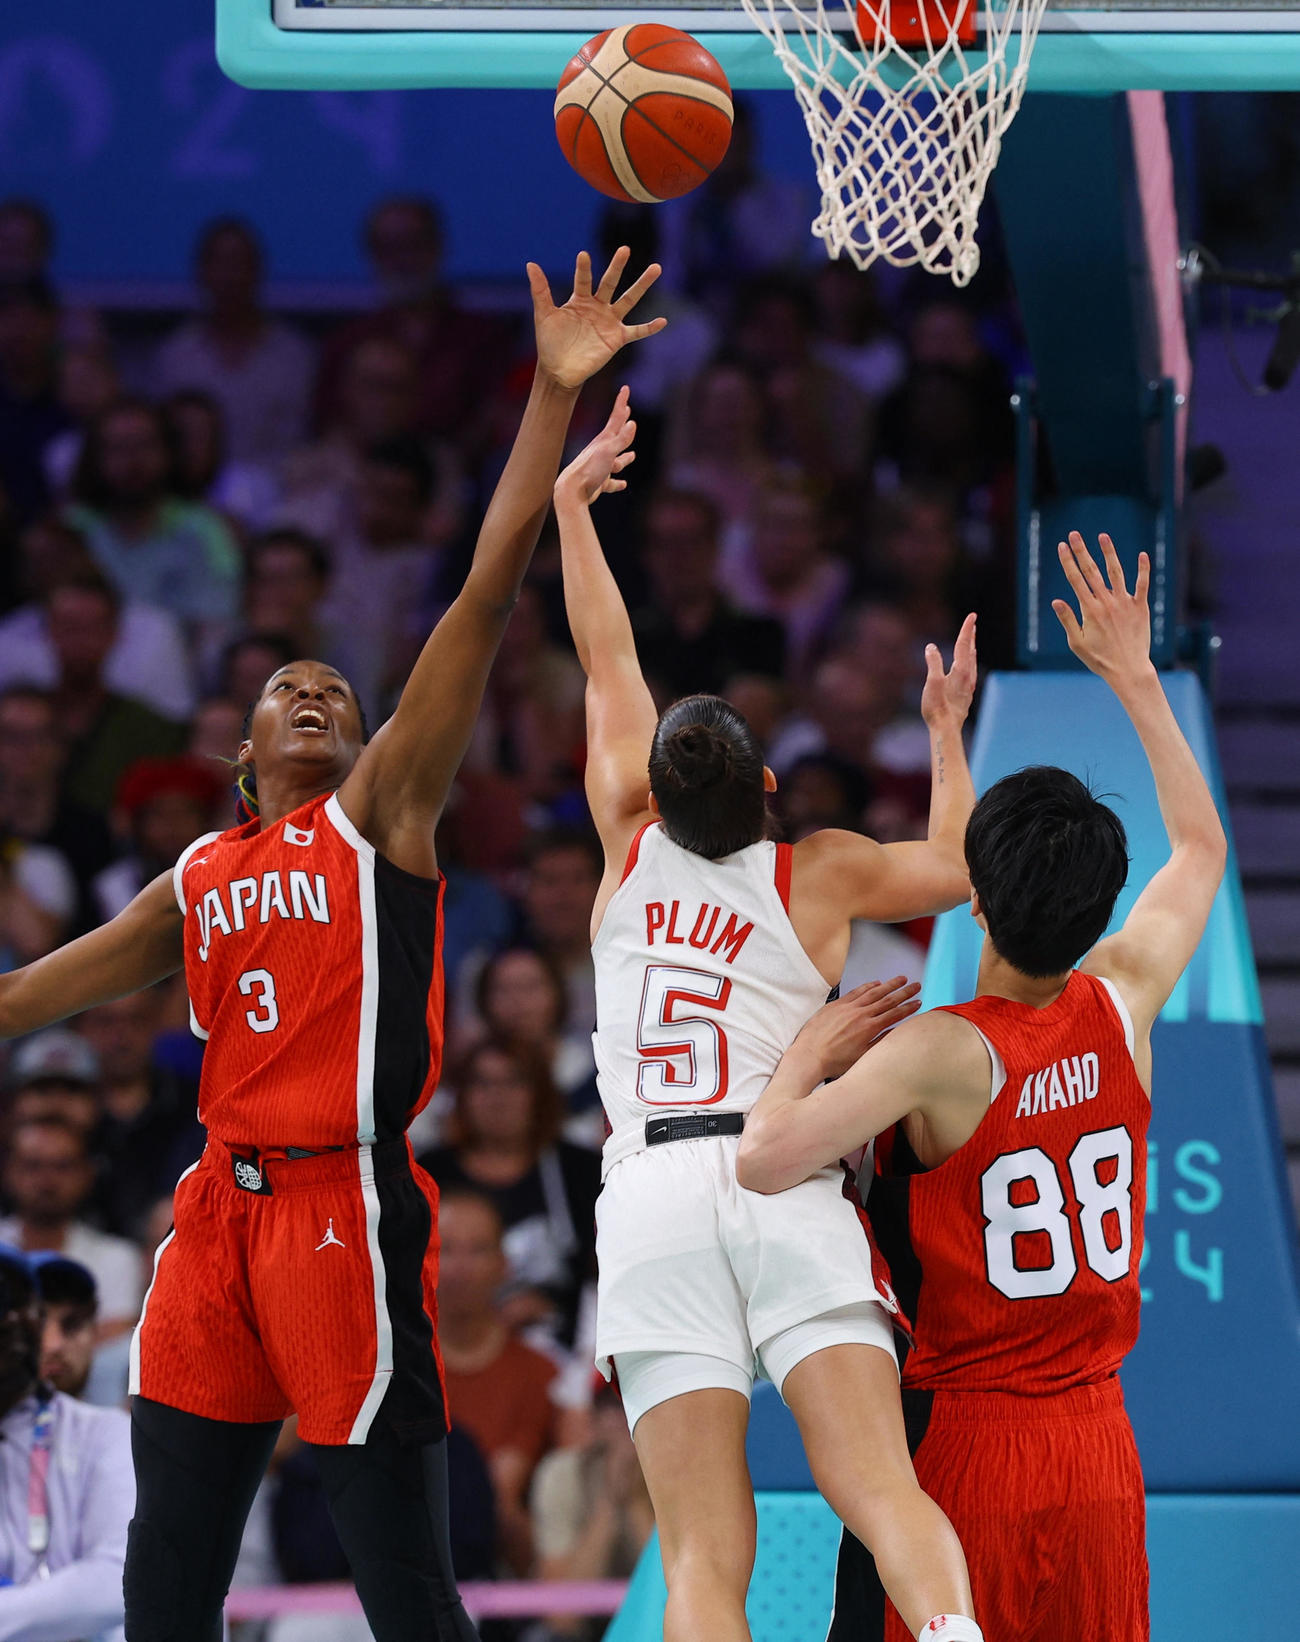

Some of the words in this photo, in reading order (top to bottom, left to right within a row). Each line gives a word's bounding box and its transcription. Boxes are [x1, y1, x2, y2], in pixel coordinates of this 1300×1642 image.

[195, 870, 331, 963] JAPAN
[645, 900, 754, 964] PLUM
[237, 968, 280, 1034] 3
[636, 965, 732, 1105] 5
[1015, 1051, 1099, 1119] AKAHO
[980, 1124, 1134, 1300] 88
[1139, 1229, 1223, 1303] 4
